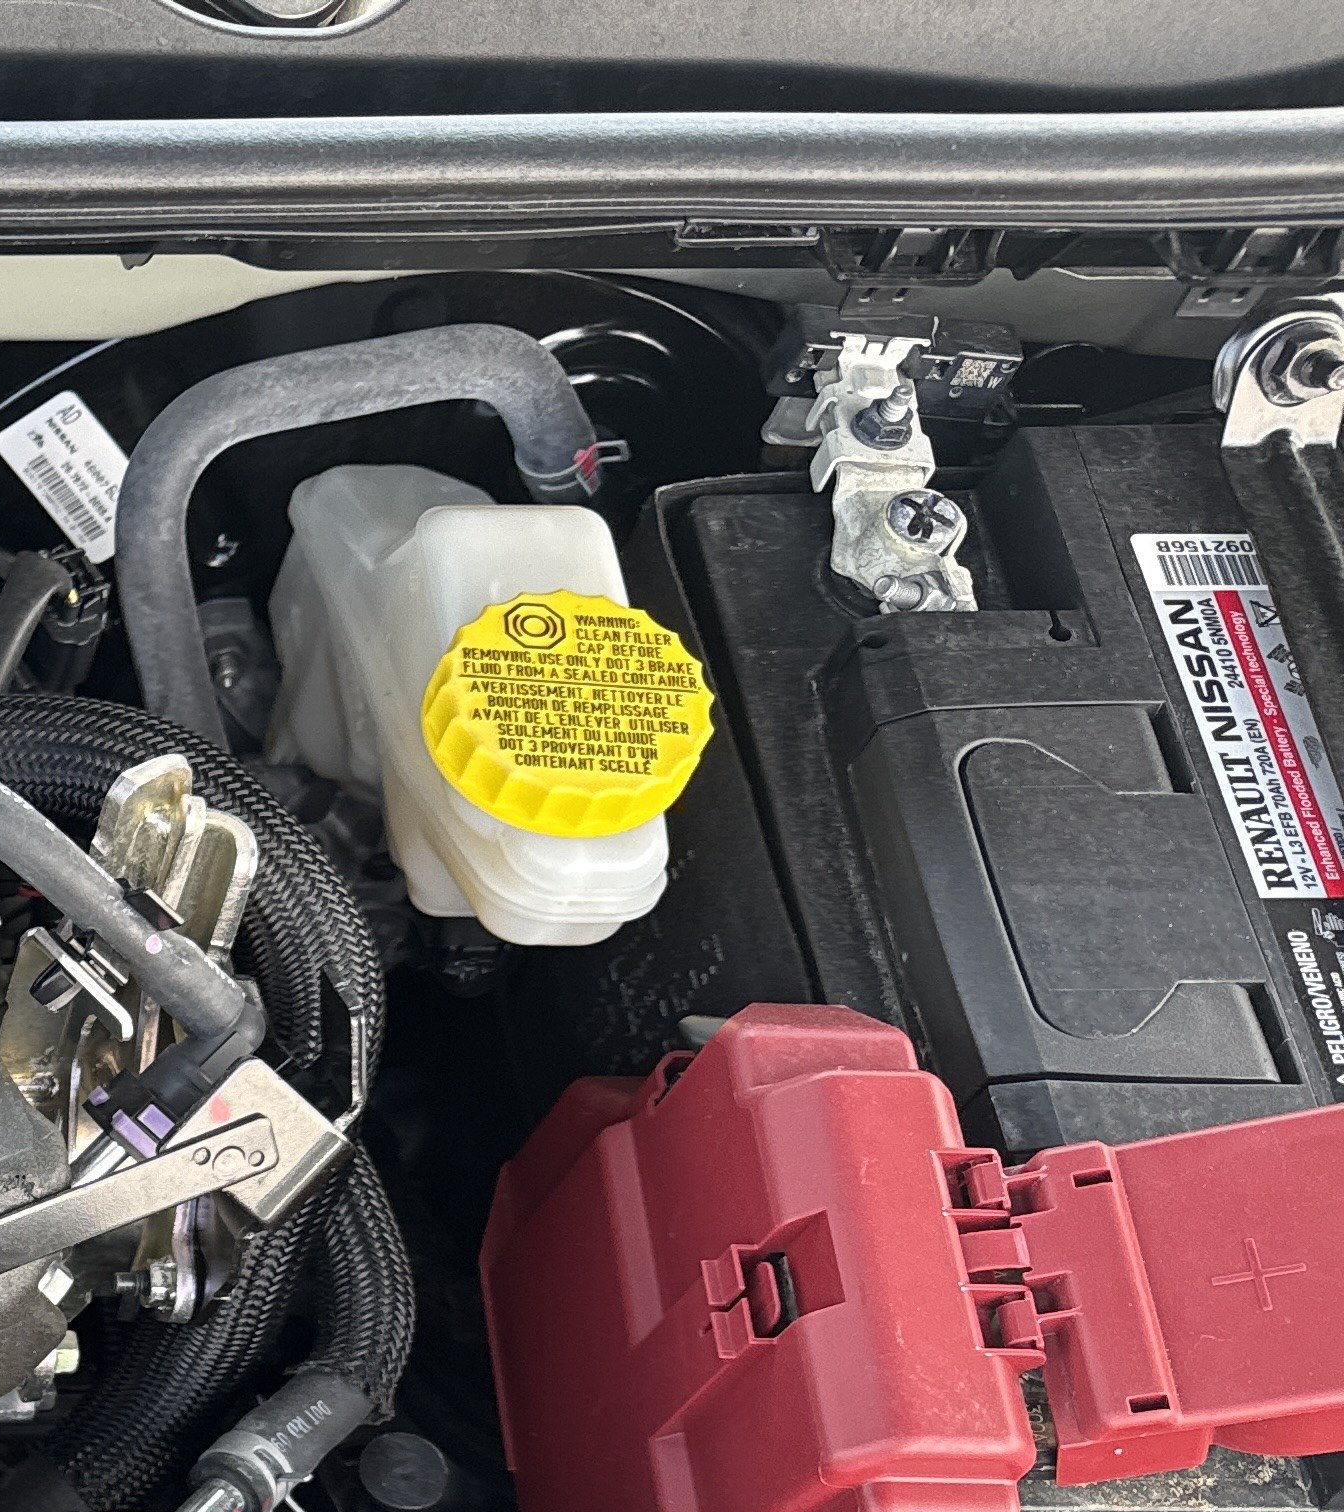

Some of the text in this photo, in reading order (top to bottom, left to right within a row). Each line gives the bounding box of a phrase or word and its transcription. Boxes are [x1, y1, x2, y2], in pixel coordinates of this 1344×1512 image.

[56, 404, 82, 425] AD
[1155, 539, 1254, 553] 092156B
[574, 614, 641, 630] WARNING:
[575, 628, 672, 647] CLEAN FILLER
[1229, 609, 1263, 674] technology
[577, 642, 663, 660] CAP BEFORE
[463, 660, 502, 677] FLUID
[507, 663, 545, 680] FROM
[550, 666, 560, 680] A
[565, 667, 618, 684] SEALED
[538, 652, 563, 667] USE
[566, 654, 601, 669] ONLY
[606, 657, 631, 671] DOT
[635, 659, 645, 672] 3
[648, 660, 694, 676] BRAKE
[1215, 648, 1245, 689] 24410
[487, 695, 669, 720] BOUCHON DE REMPLISSAGE
[593, 688, 663, 706] NETTOYER
[666, 693, 683, 706] LE
[1253, 674, 1279, 717] Special
[472, 708, 519, 723] AVANT
[525, 711, 542, 725] DE
[629, 717, 689, 736] UTILISER
[498, 722, 658, 747] SEULEMENT DU LIQUIDE
[1242, 717, 1268, 745] (EN)
[498, 737, 524, 751] DOT
[528, 739, 538, 752] 3
[541, 741, 623, 759] PROVENANT
[1163, 598, 1299, 891] RENAULT NISSAN
[1272, 724, 1298, 768] Battery
[514, 752, 652, 776] CONTENANT SCELLÉ
[1253, 745, 1277, 777] 720A
[1266, 778, 1287, 810] 70Ah
[1286, 770, 1318, 818] Flooded
[1277, 811, 1300, 838] EFB
[1291, 840, 1307, 857] L3
[1305, 820, 1341, 881] Enhanced
[1297, 864, 1318, 890] 12V
